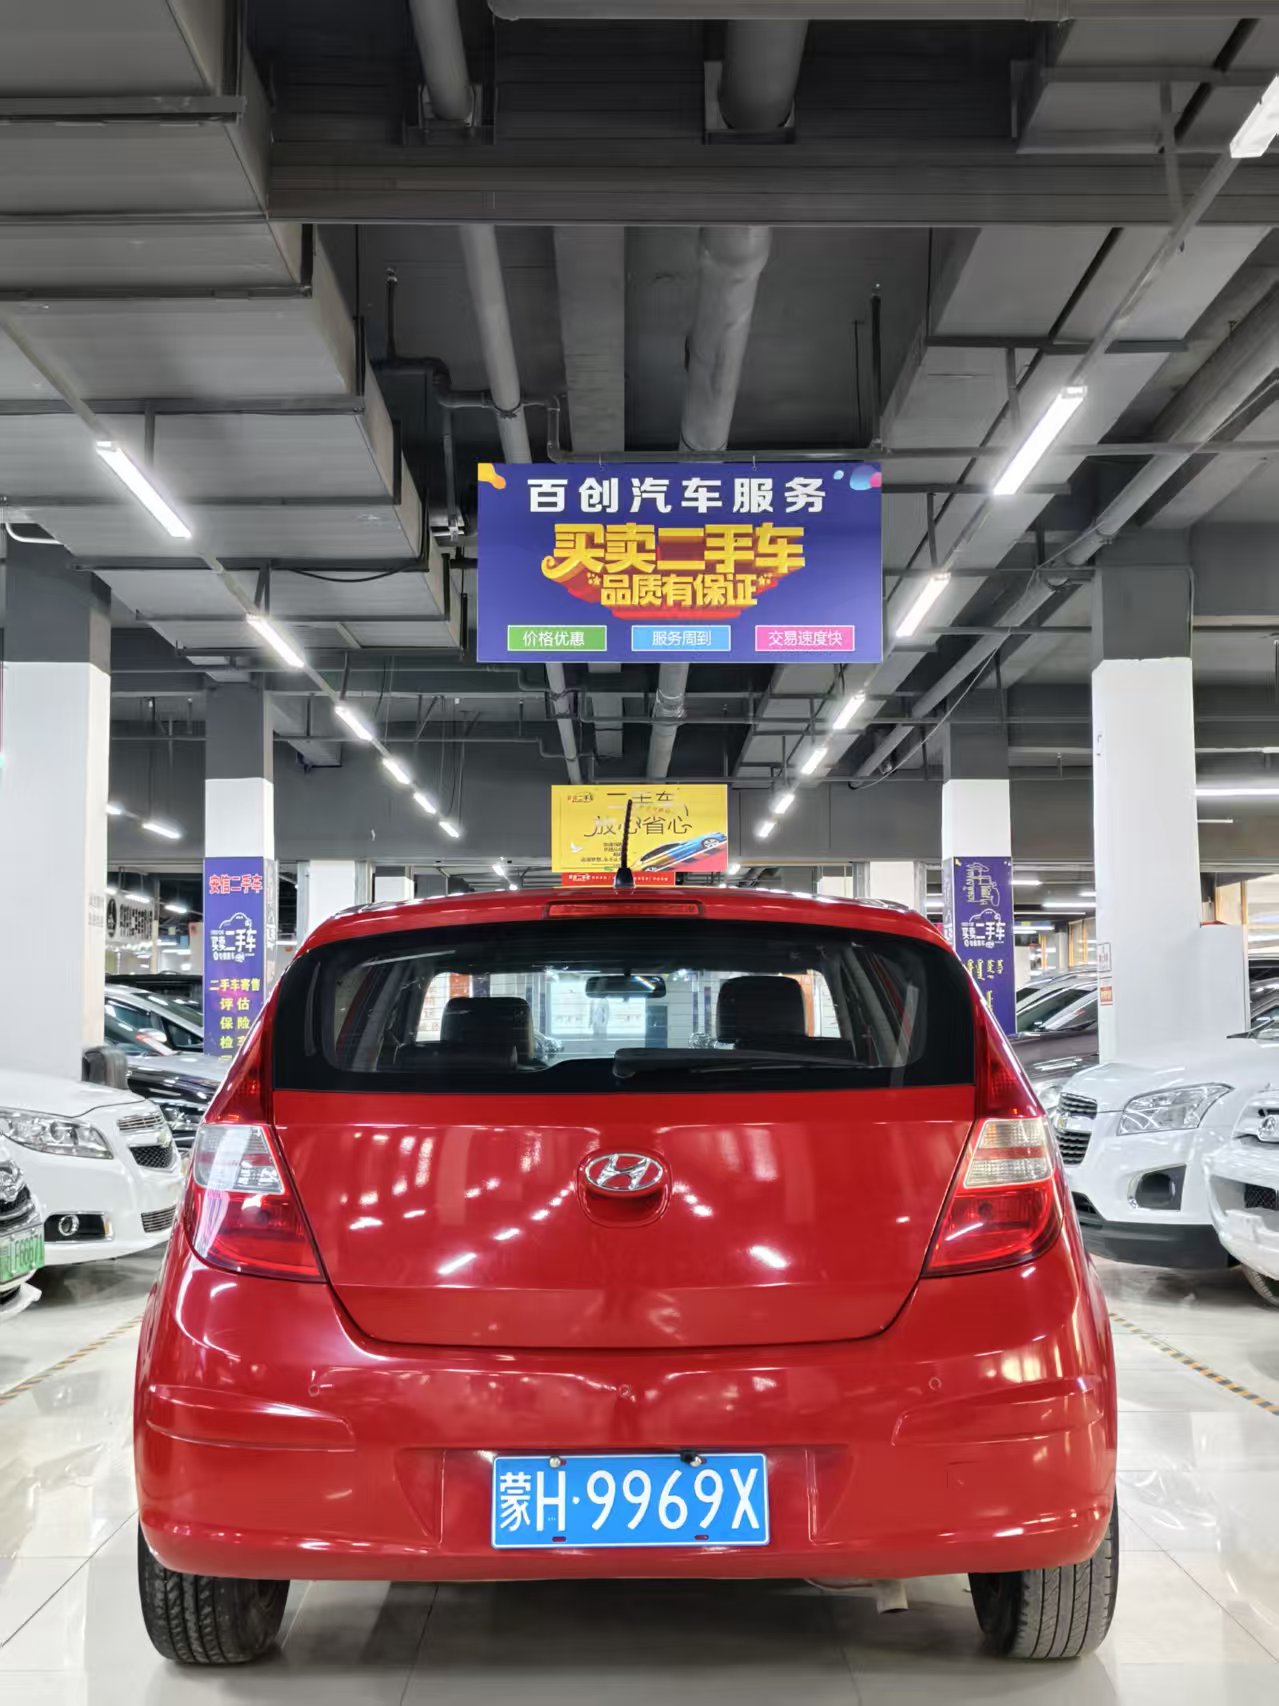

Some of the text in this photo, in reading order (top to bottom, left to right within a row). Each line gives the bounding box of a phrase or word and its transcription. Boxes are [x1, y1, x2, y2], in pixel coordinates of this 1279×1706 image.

[527, 477, 826, 514] 百创汽车服务
[545, 522, 806, 576] 买卖二手车
[601, 573, 758, 606] 品质有保证
[522, 630, 585, 648] 价格优惠
[652, 630, 713, 648] 服务周到
[767, 630, 843, 648] 交易速度快
[209, 874, 263, 894] 安信二手车
[219, 997, 250, 1011] 评估
[219, 1016, 250, 1030] 保险
[500, 1468, 760, 1532] 蒙H·9969X
